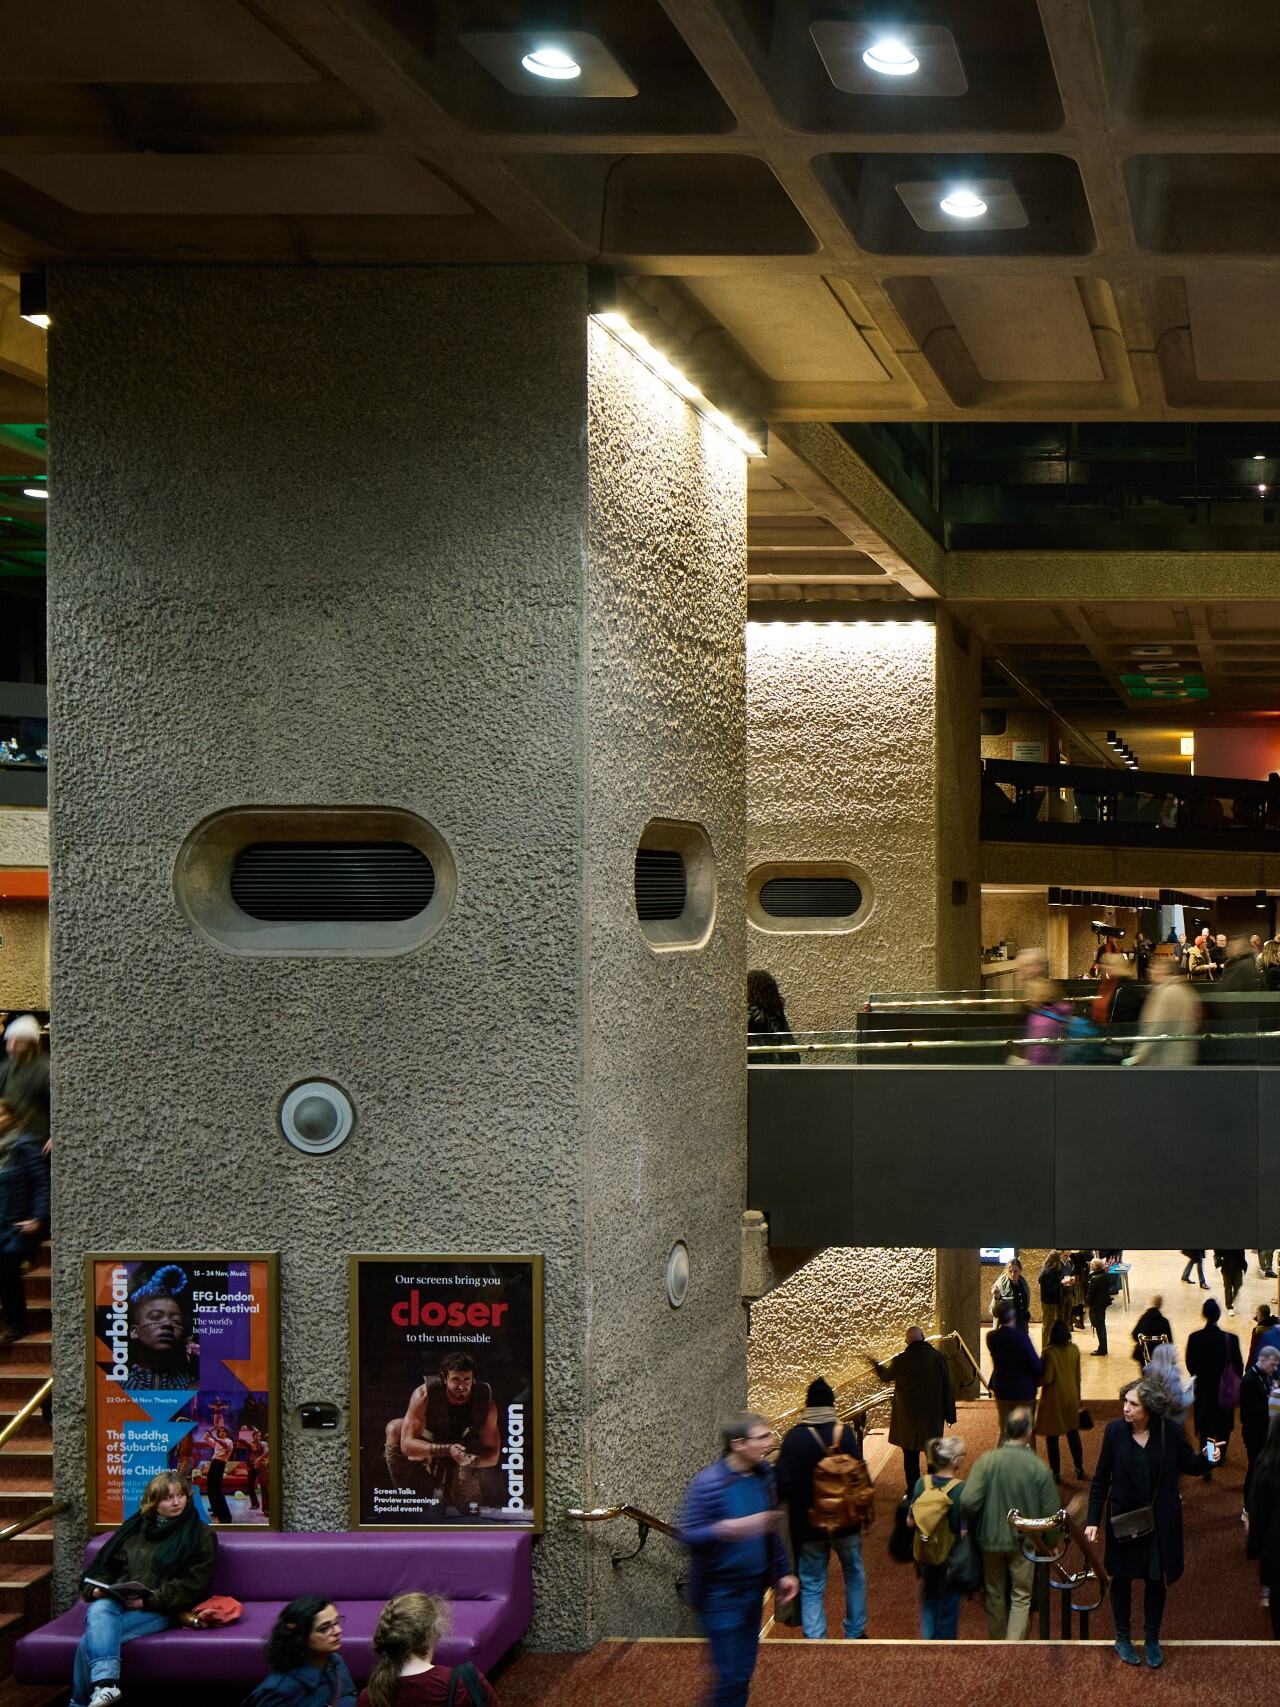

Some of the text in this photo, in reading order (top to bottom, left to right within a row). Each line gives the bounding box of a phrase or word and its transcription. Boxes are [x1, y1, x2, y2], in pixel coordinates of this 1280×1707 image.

[215, 1270, 229, 1278] Nov,
[395, 1275, 501, 1288] Our screens bring you
[192, 1291, 255, 1302] EFG London
[192, 1303, 260, 1313] Jazz Festival
[391, 1290, 509, 1328] closer
[105, 1268, 129, 1381] barbican
[192, 1317, 233, 1326] The world's
[192, 1326, 224, 1336] best Jazz
[406, 1332, 492, 1344] to the unmissable
[106, 1429, 169, 1440] The Buddha
[106, 1441, 168, 1452] of Suburbia
[106, 1453, 133, 1464] RSC/
[501, 1403, 525, 1514] barbican
[106, 1465, 133, 1475] Wise
[373, 1487, 416, 1495] Screen Talks
[374, 1496, 440, 1506] Preview screenings
[374, 1504, 399, 1514] Special
